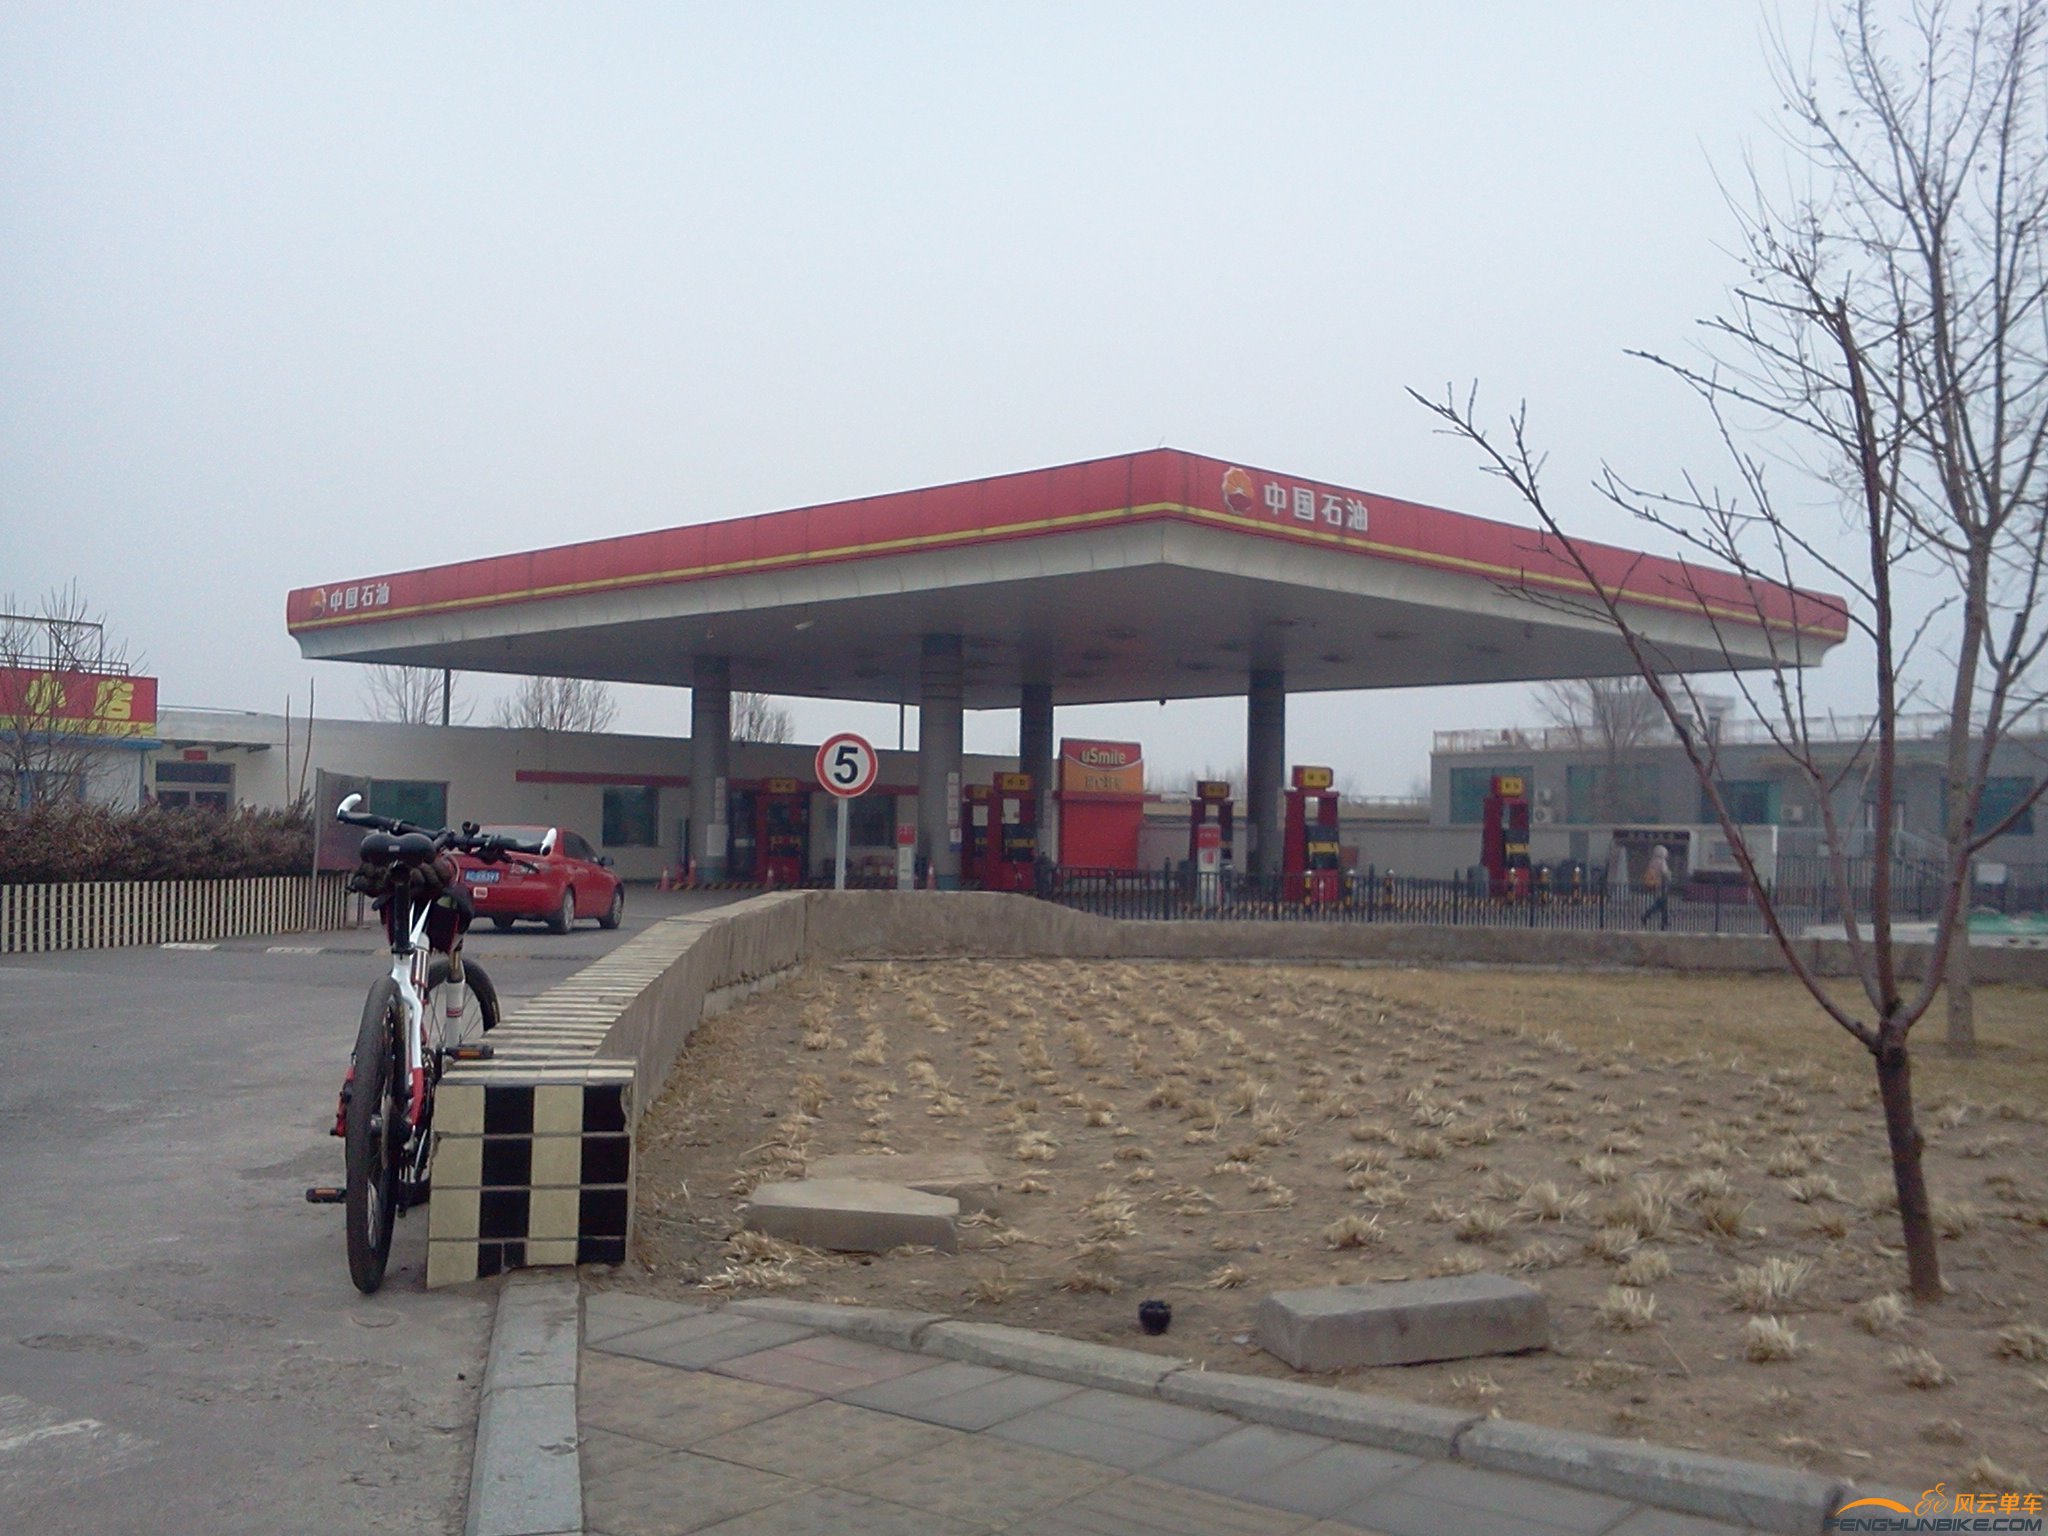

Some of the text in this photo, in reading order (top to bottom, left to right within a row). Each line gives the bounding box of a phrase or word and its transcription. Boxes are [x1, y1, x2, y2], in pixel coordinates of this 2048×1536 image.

[1265, 481, 1367, 531] 中国石油
[330, 582, 390, 612] 中国石油
[834, 746, 858, 784] 5
[1080, 747, 1126, 764] uSmile
